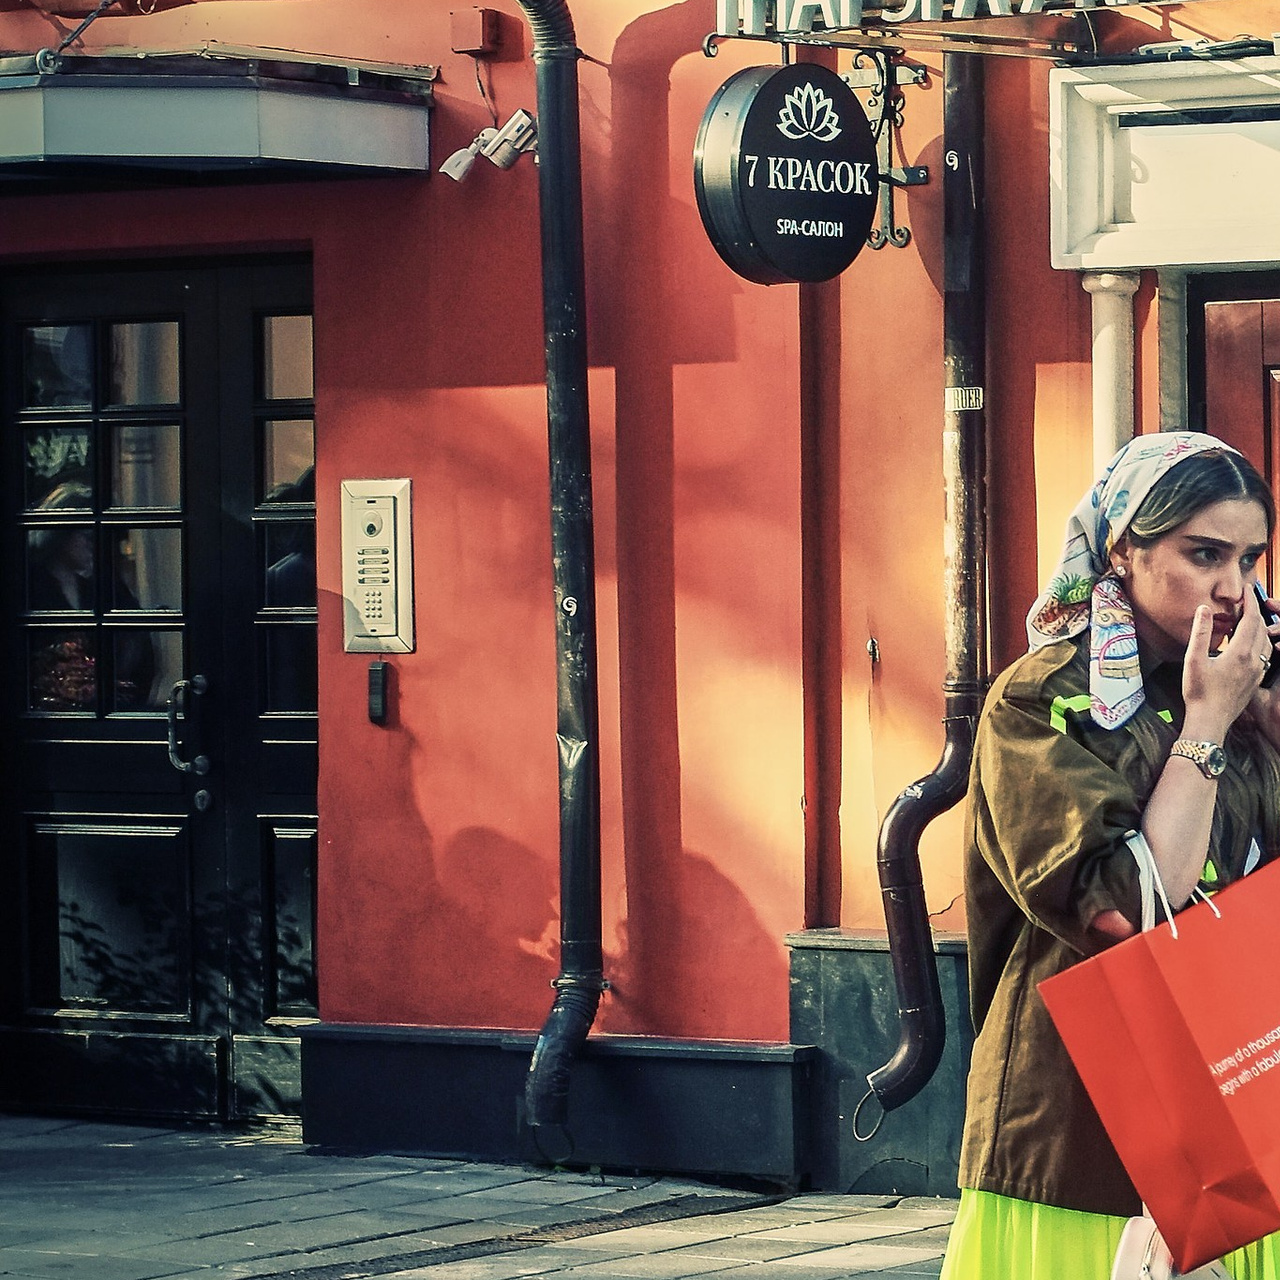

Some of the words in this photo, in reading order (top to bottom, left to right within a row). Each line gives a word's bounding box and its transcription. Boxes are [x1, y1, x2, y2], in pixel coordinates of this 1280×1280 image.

[744, 155, 758, 187] 7
[767, 156, 872, 195] КРАСОК
[776, 218, 844, 238] SPA-САЛОН
